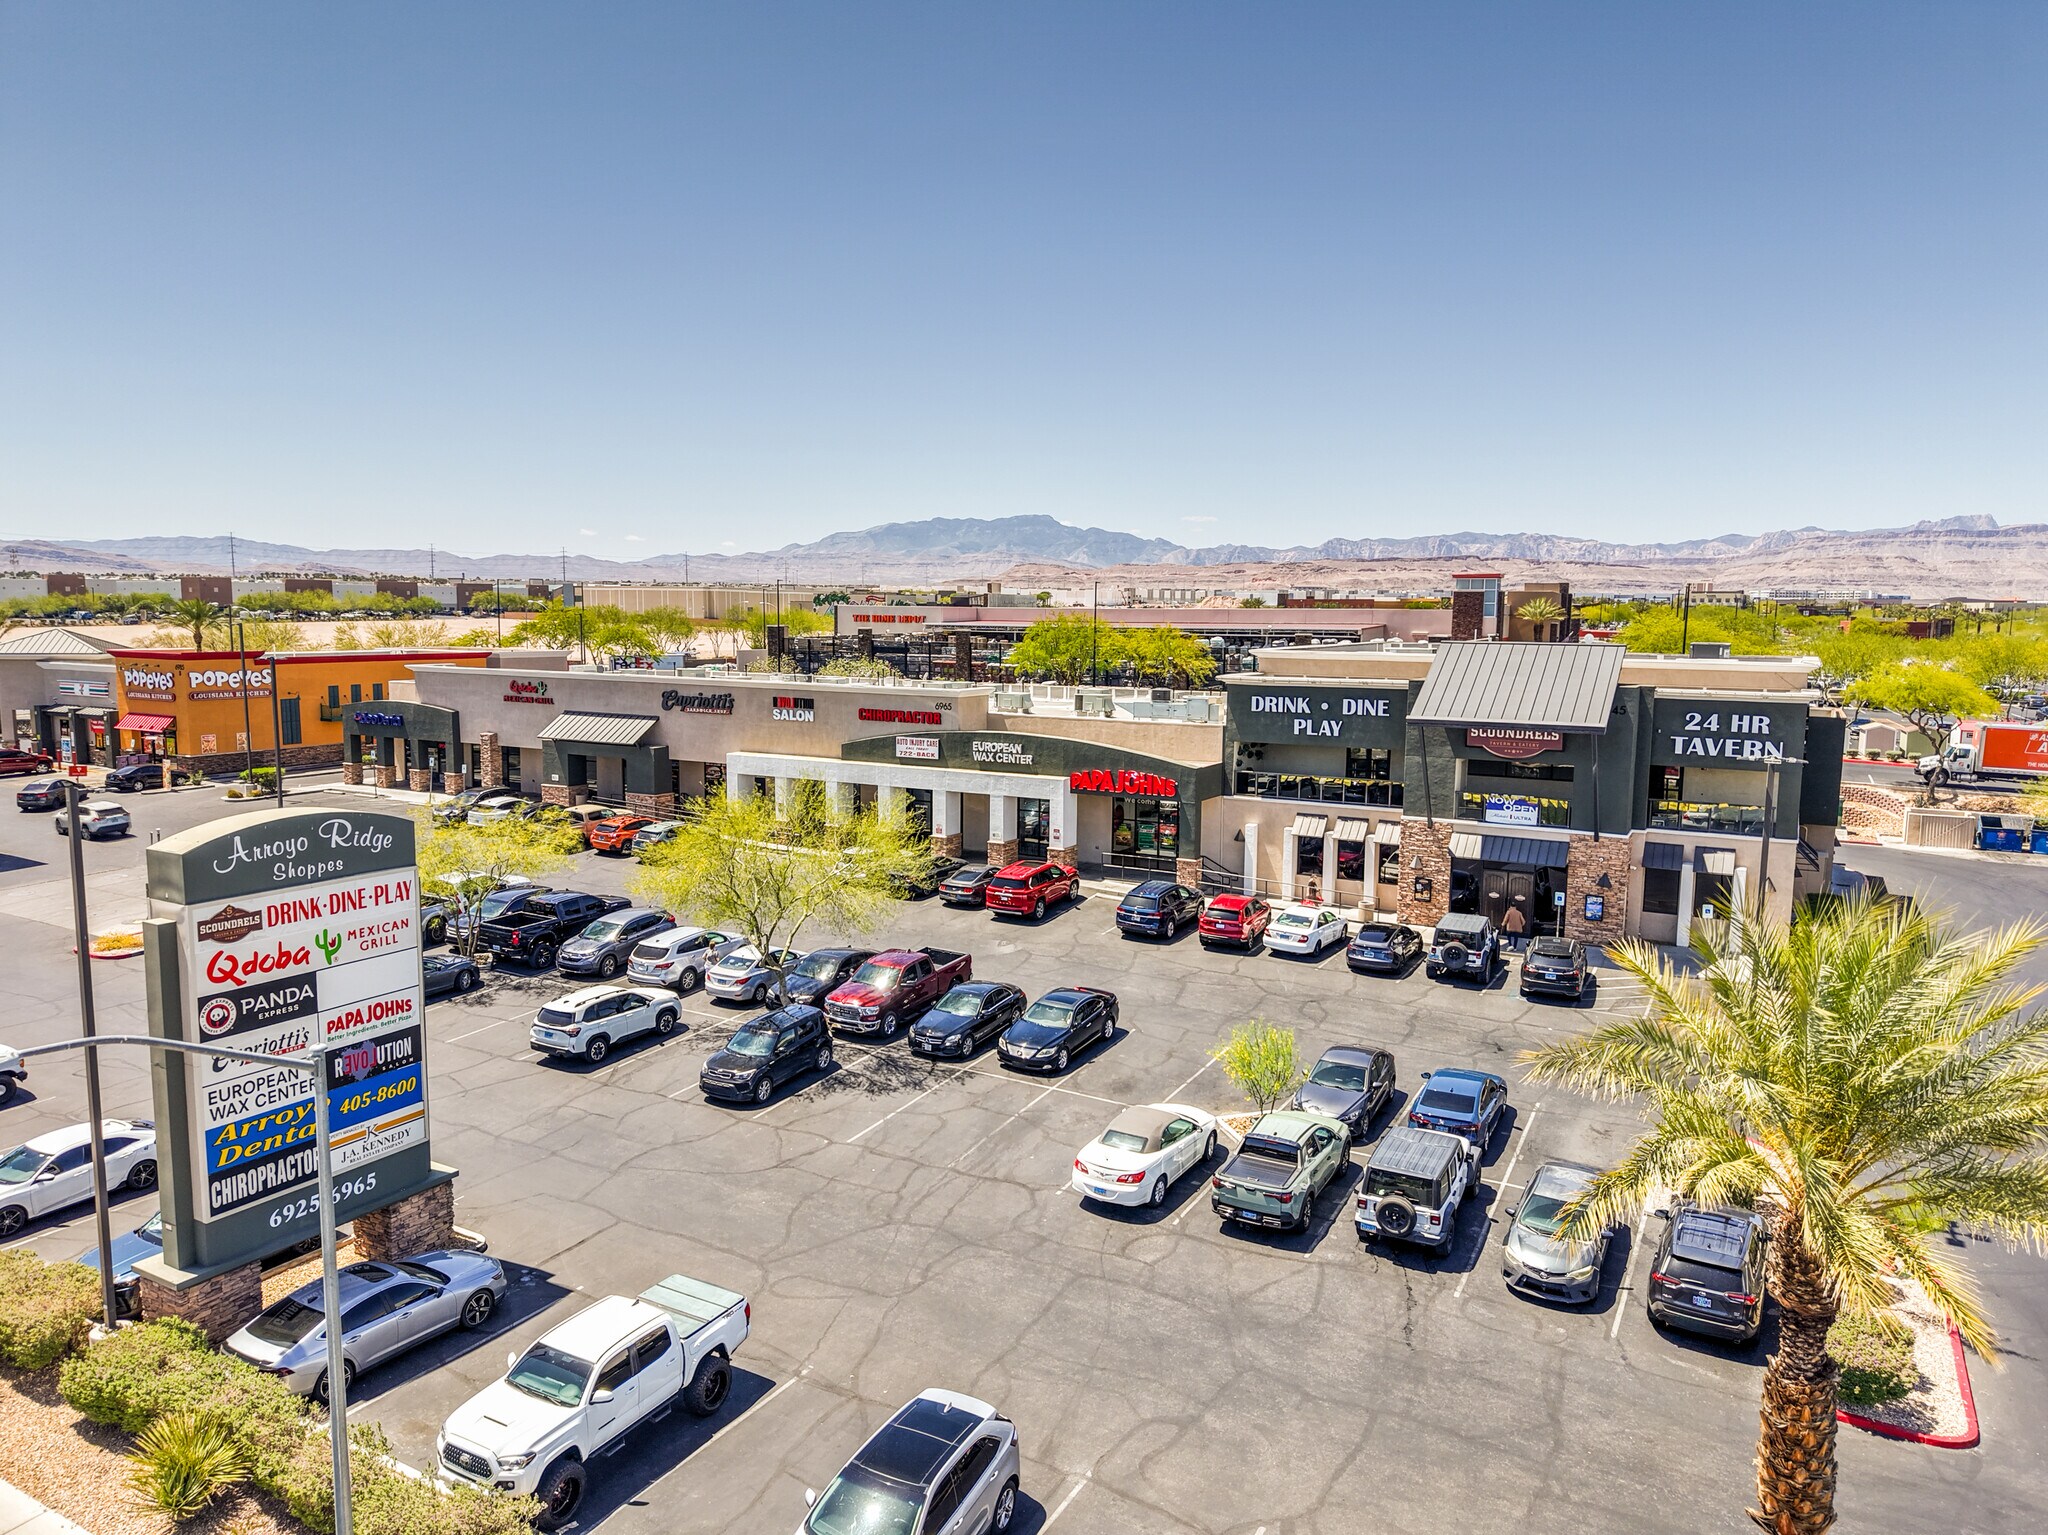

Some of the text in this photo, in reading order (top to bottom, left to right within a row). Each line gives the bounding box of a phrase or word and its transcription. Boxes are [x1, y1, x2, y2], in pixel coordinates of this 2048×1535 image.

[872, 614, 896, 623] HOME
[897, 615, 926, 623] DEPOT
[152, 692, 172, 700] KITCHEN
[194, 690, 270, 699] LOUISIANA KITCHEN
[661, 689, 736, 715] Capriotti's
[773, 708, 814, 722] SALON
[858, 708, 942, 725] CHIROPRACTOR
[934, 702, 952, 711] 6965
[1251, 696, 1390, 717] DRINK DINE
[1293, 719, 1343, 737] PLAY
[1684, 712, 1771, 734] 24 HR
[896, 738, 908, 746] AUTO
[909, 738, 925, 746] INJURY
[1471, 728, 1559, 740] SCOUNDRELS
[972, 741, 1022, 754] EUROPEAN
[1670, 736, 1784, 759] TAVERN
[973, 752, 1033, 765] WAX CENTER
[1070, 770, 1176, 797] PAPA JOHNS
[1124, 797, 1156, 805] Wecome
[1487, 797, 1515, 805] NOW
[1503, 805, 1538, 813] OPEN
[214, 818, 393, 874] Arroyo Ridge
[273, 860, 344, 881] Shoppes
[266, 879, 412, 928] DRINK DINE PLAY
[200, 915, 260, 934] SCOUNDRELS
[347, 918, 410, 942] MEXICAN
[360, 934, 398, 952] GRILL
[206, 941, 310, 987] Qdoba
[201, 998, 234, 1018] PANDA EXPRESS
[241, 984, 314, 1015] PANDA
[258, 1004, 299, 1020] EXPRESS
[326, 999, 413, 1034] PAPA JOHNS
[327, 1033, 345, 1042] Better
[380, 1018, 397, 1027] Better
[212, 1026, 310, 1072] Criotti's
[382, 1057, 414, 1071] SALON
[208, 1068, 299, 1106] EUROPEAN
[339, 1076, 417, 1114] 405-8600
[210, 1103, 249, 1122] WAX
[217, 1124, 317, 1168] Denta
[341, 1128, 411, 1164] J.A. KENNEDY
[349, 1140, 404, 1164] REAL ESTATE COMPANY
[211, 1148, 319, 1208] CHIROPRACTOR
[270, 1195, 320, 1228] 6925
